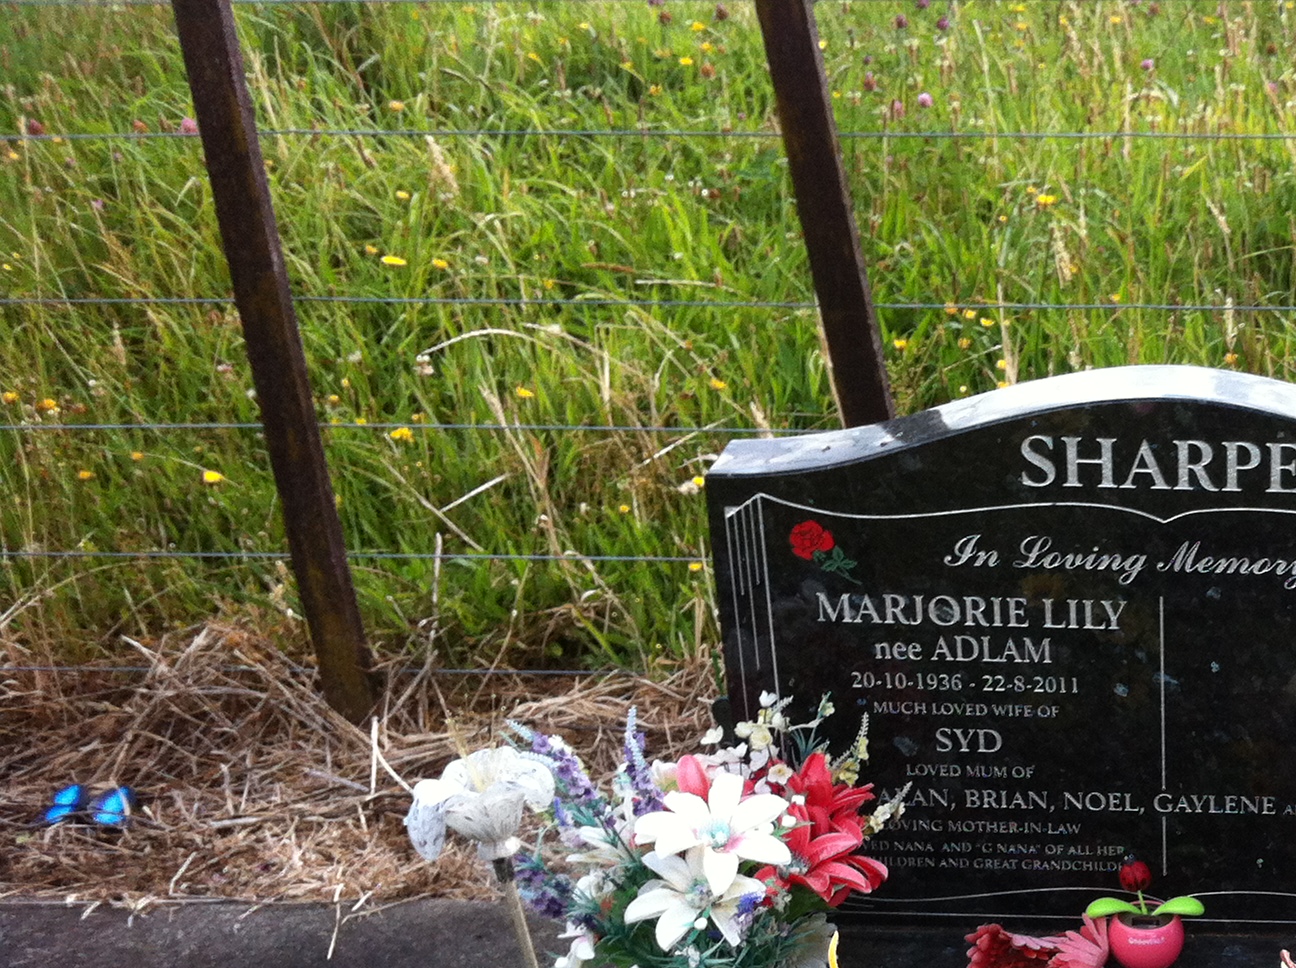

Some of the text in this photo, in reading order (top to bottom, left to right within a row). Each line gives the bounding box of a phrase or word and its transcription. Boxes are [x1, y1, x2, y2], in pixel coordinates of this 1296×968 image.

[944, 534, 1001, 568] In
[1014, 535, 1145, 584] Loving
[816, 592, 1127, 631] MARJORIE LILY
[875, 635, 1053, 664] nee ADLAM
[850, 671, 963, 691] 20-10-1936
[981, 674, 1080, 694] 22-8-2011
[872, 701, 1061, 719] MUCH LOVED WIFE OF
[935, 727, 1003, 753] SYD
[905, 763, 1036, 779] LOVED MUM OF
[964, 788, 1056, 813] BRIAN,
[1063, 791, 1146, 816] NOEL,
[1153, 793, 1277, 816] GAYLENE
[884, 820, 1082, 835] OVING MOTHER-IN-LAW
[893, 840, 935, 852] NANA
[942, 842, 973, 853] AND
[1044, 843, 1064, 855] OF
[1066, 844, 1094, 856] ALL
[1096, 845, 1125, 857] HER
[939, 856, 970, 869] AND
[973, 857, 1019, 870] GREAT
[1021, 859, 1123, 872] GRANDCHILD
